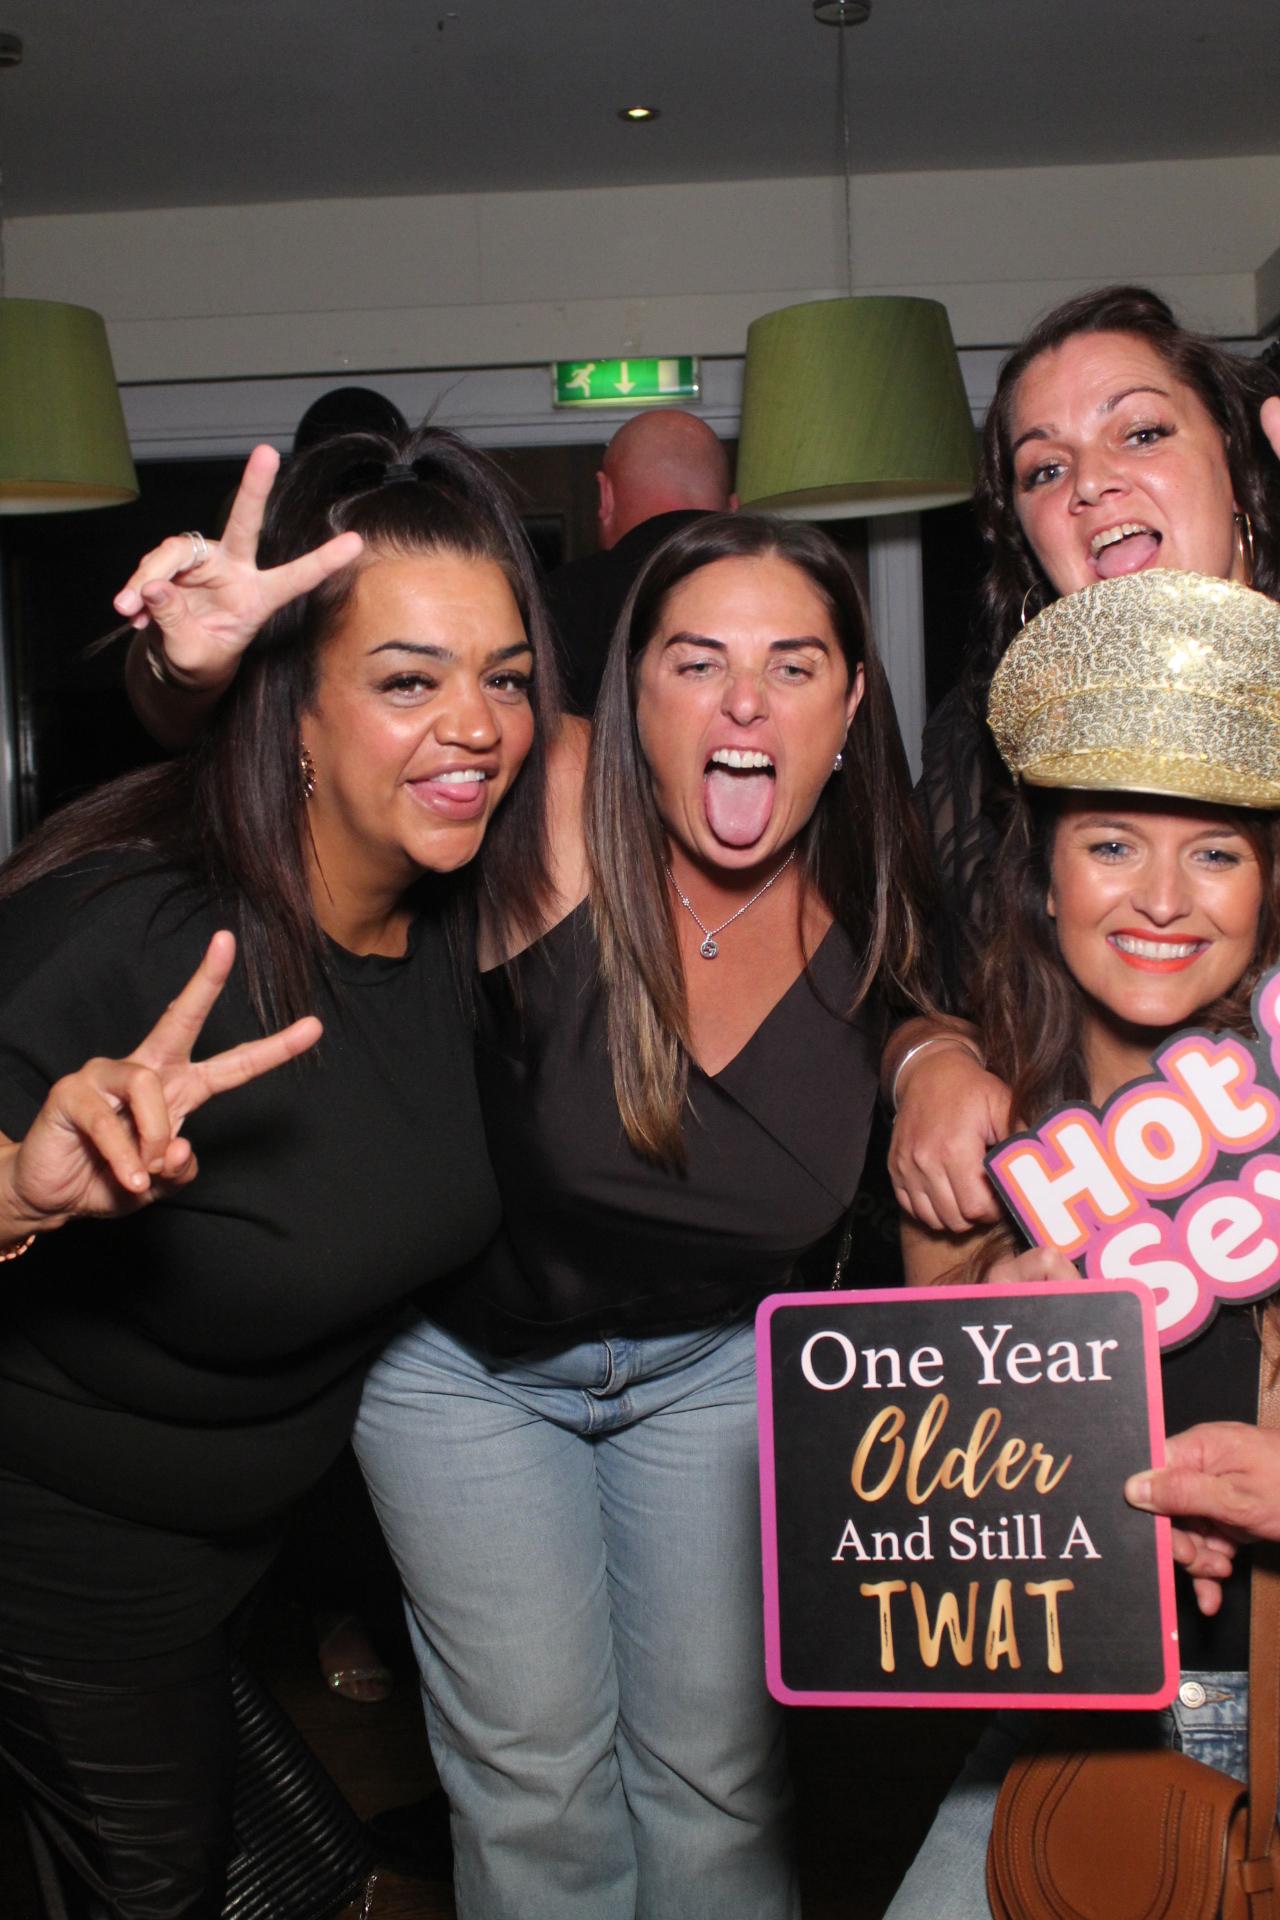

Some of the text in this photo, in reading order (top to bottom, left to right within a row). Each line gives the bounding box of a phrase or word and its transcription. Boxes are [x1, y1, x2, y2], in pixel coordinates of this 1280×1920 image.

[1007, 1051, 1268, 1247] Hot
[800, 1324, 1118, 1391] One Year
[850, 1393, 1072, 1505] Older
[831, 1514, 1102, 1561] And Still A
[859, 1578, 1075, 1673] TWAT
